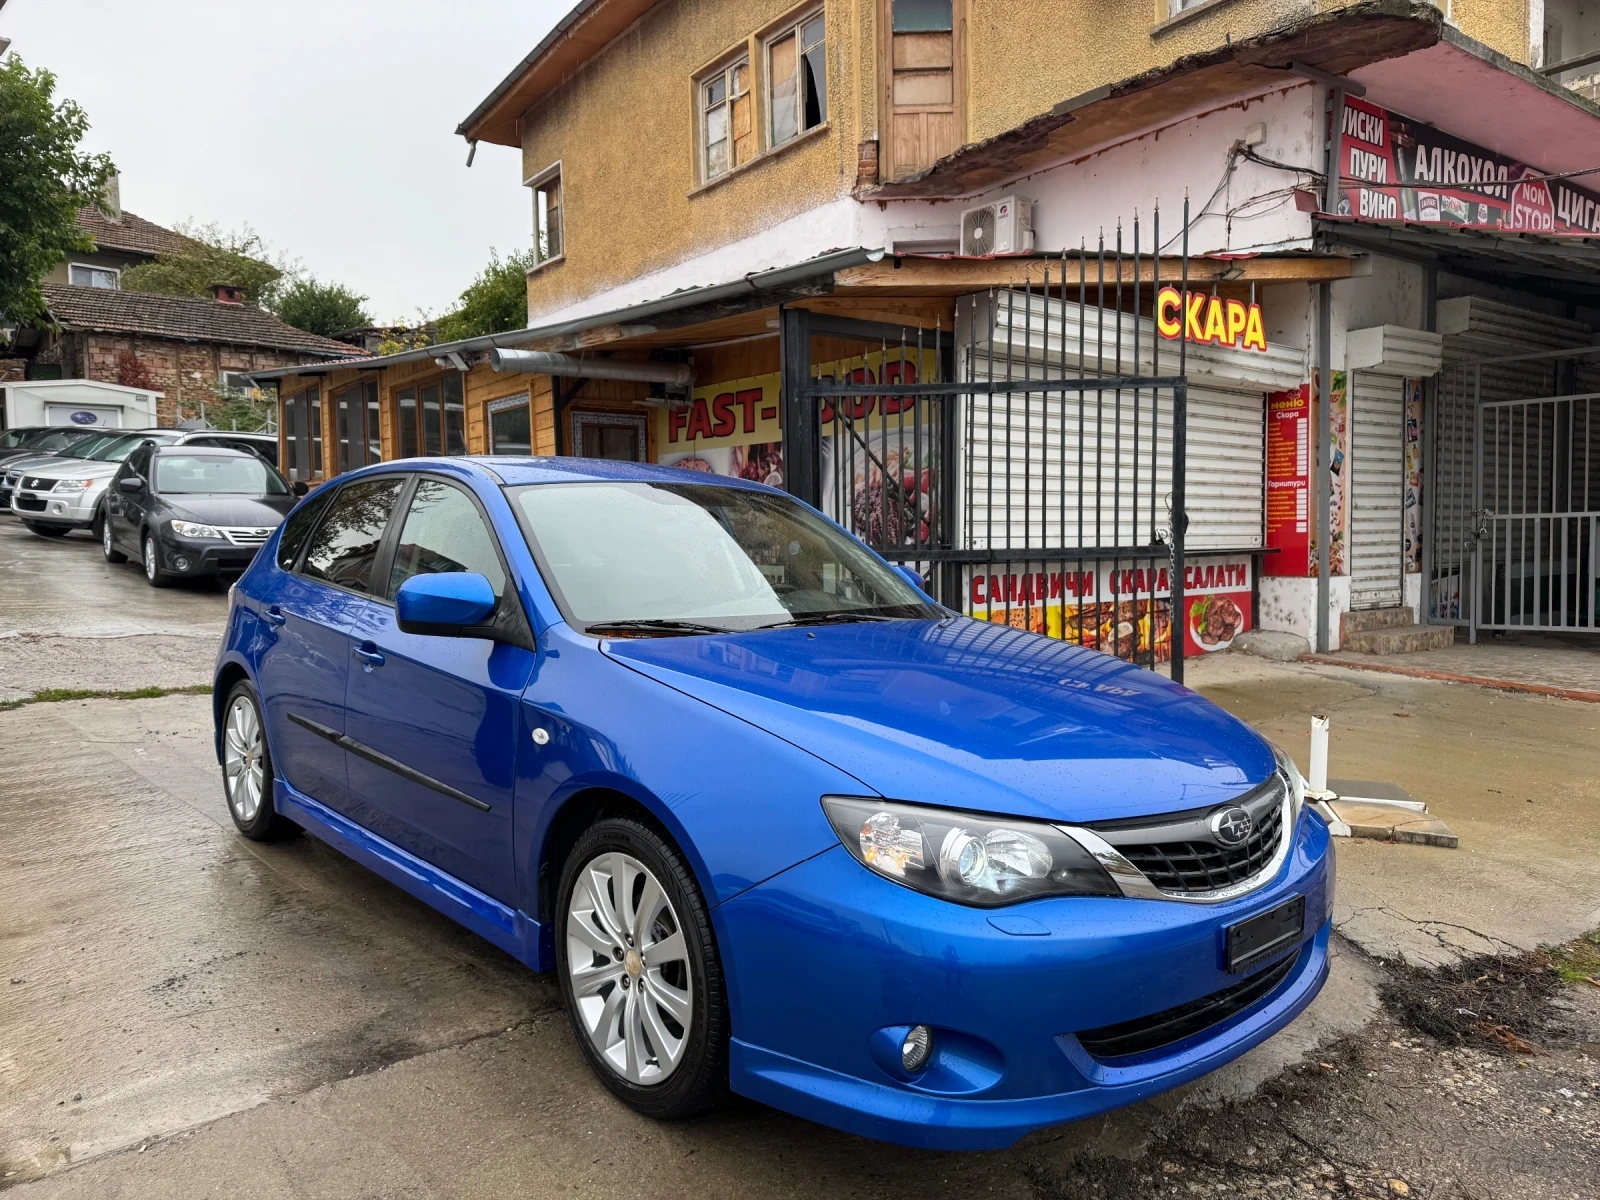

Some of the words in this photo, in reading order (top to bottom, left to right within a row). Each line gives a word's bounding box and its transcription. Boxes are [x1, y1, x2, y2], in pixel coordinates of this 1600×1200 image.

[1350, 147, 1387, 184] ПУРИ
[1414, 144, 1508, 199] АЛКОХОЛ
[1359, 188, 1397, 218] ВИНО
[1522, 182, 1545, 206] NON
[1515, 203, 1551, 230] STOP
[1153, 286, 1267, 352] СКАРА
[1276, 411, 1299, 420] Скара
[1268, 480, 1306, 489] Гарнитури
[972, 571, 1094, 606] САНДВИЧИ
[1109, 567, 1170, 595] СКАРА
[1184, 563, 1247, 590] САЛАТИ
